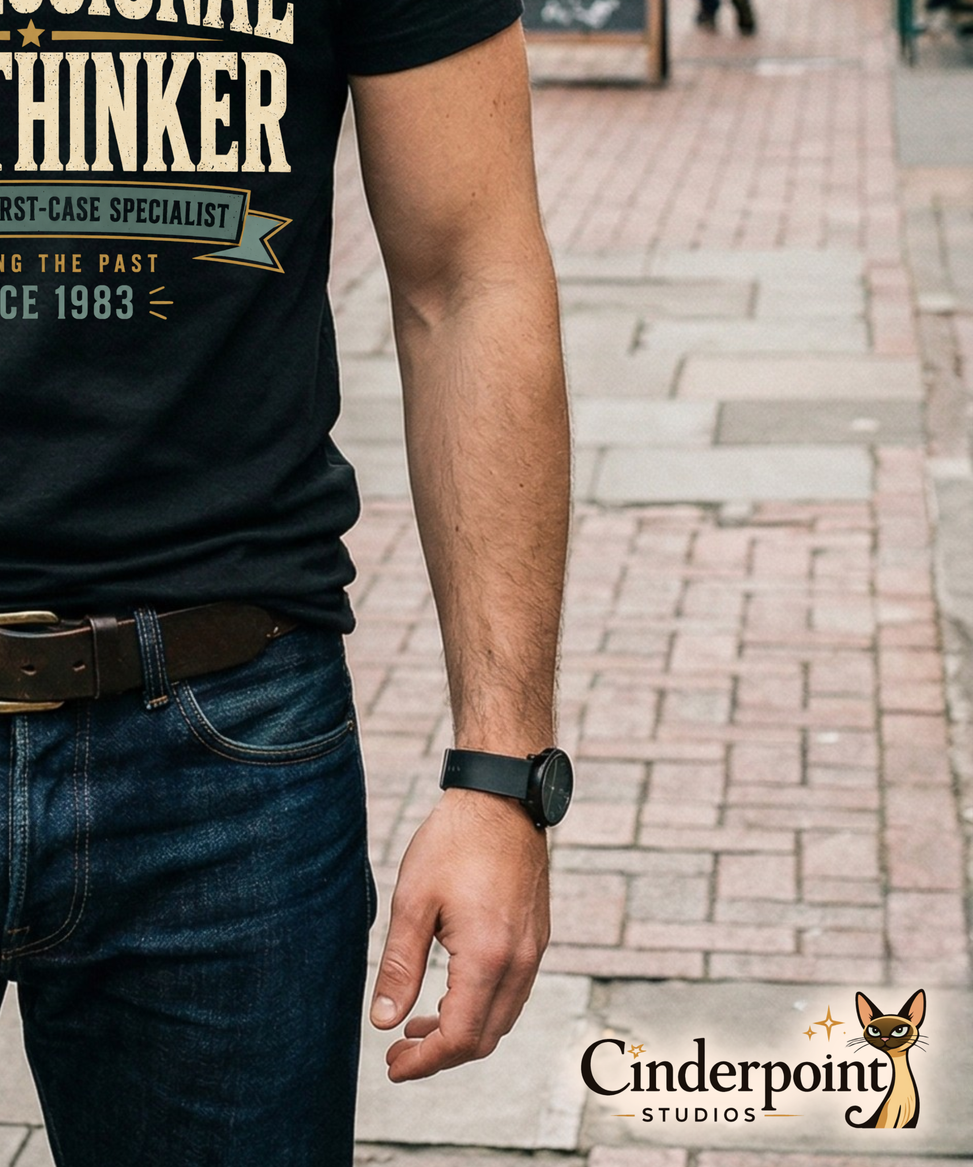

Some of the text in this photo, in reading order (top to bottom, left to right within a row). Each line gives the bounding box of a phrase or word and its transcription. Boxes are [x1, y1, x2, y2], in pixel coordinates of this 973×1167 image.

[109, 196, 230, 229] SPECIALIST
[38, 253, 82, 273] THE
[99, 253, 158, 273] PAST
[54, 284, 134, 320] 1983
